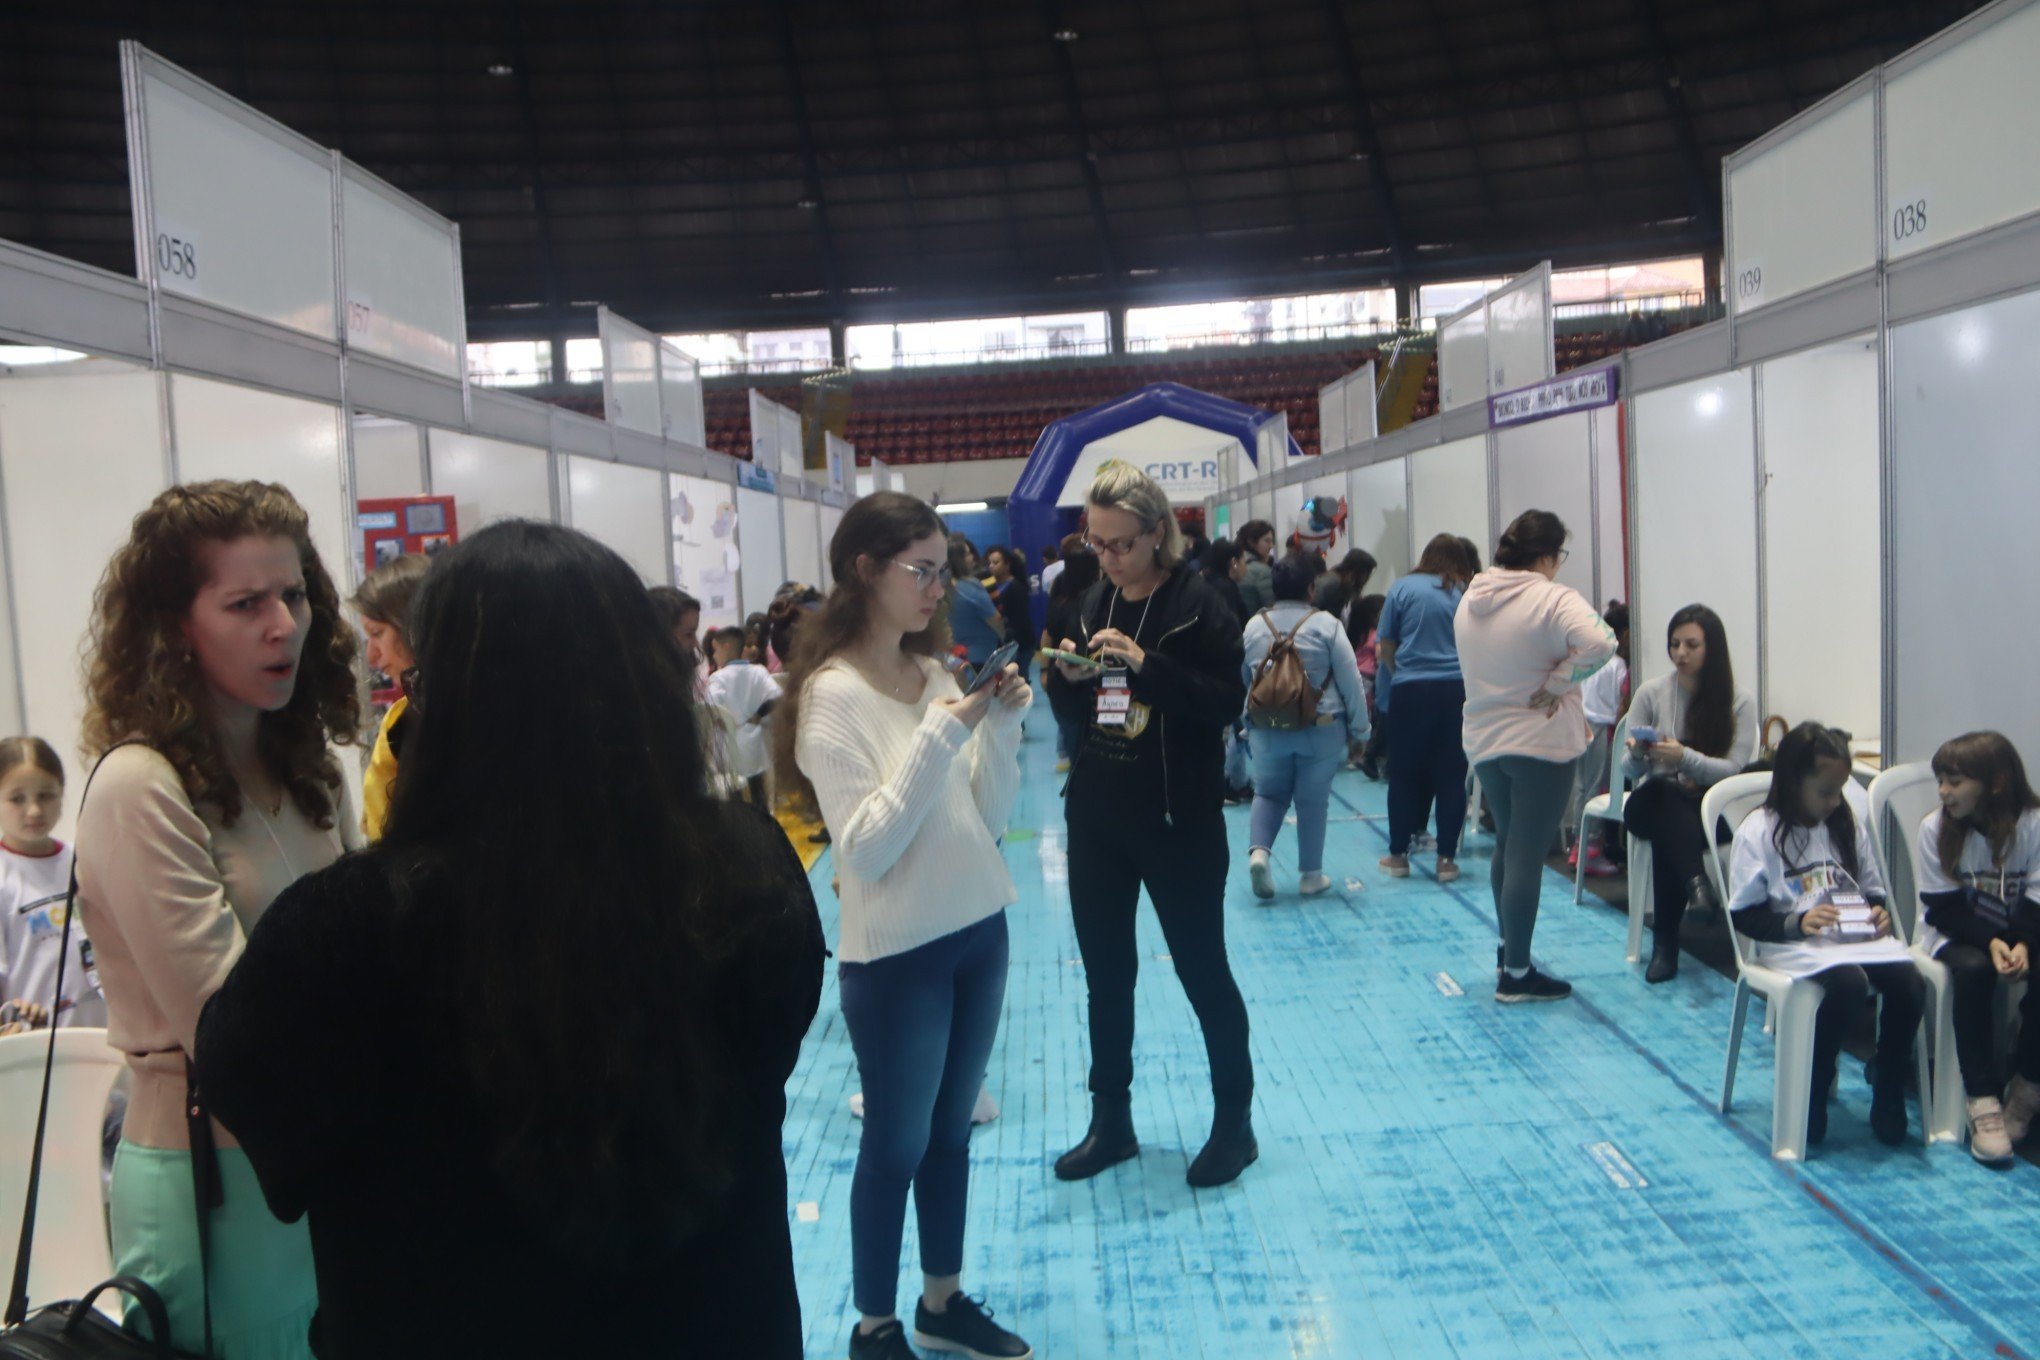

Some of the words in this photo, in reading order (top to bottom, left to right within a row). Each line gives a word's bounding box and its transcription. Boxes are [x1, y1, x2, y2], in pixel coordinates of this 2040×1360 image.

[1894, 199, 1927, 241] 038
[157, 233, 196, 280] 058
[1738, 266, 1761, 298] 039
